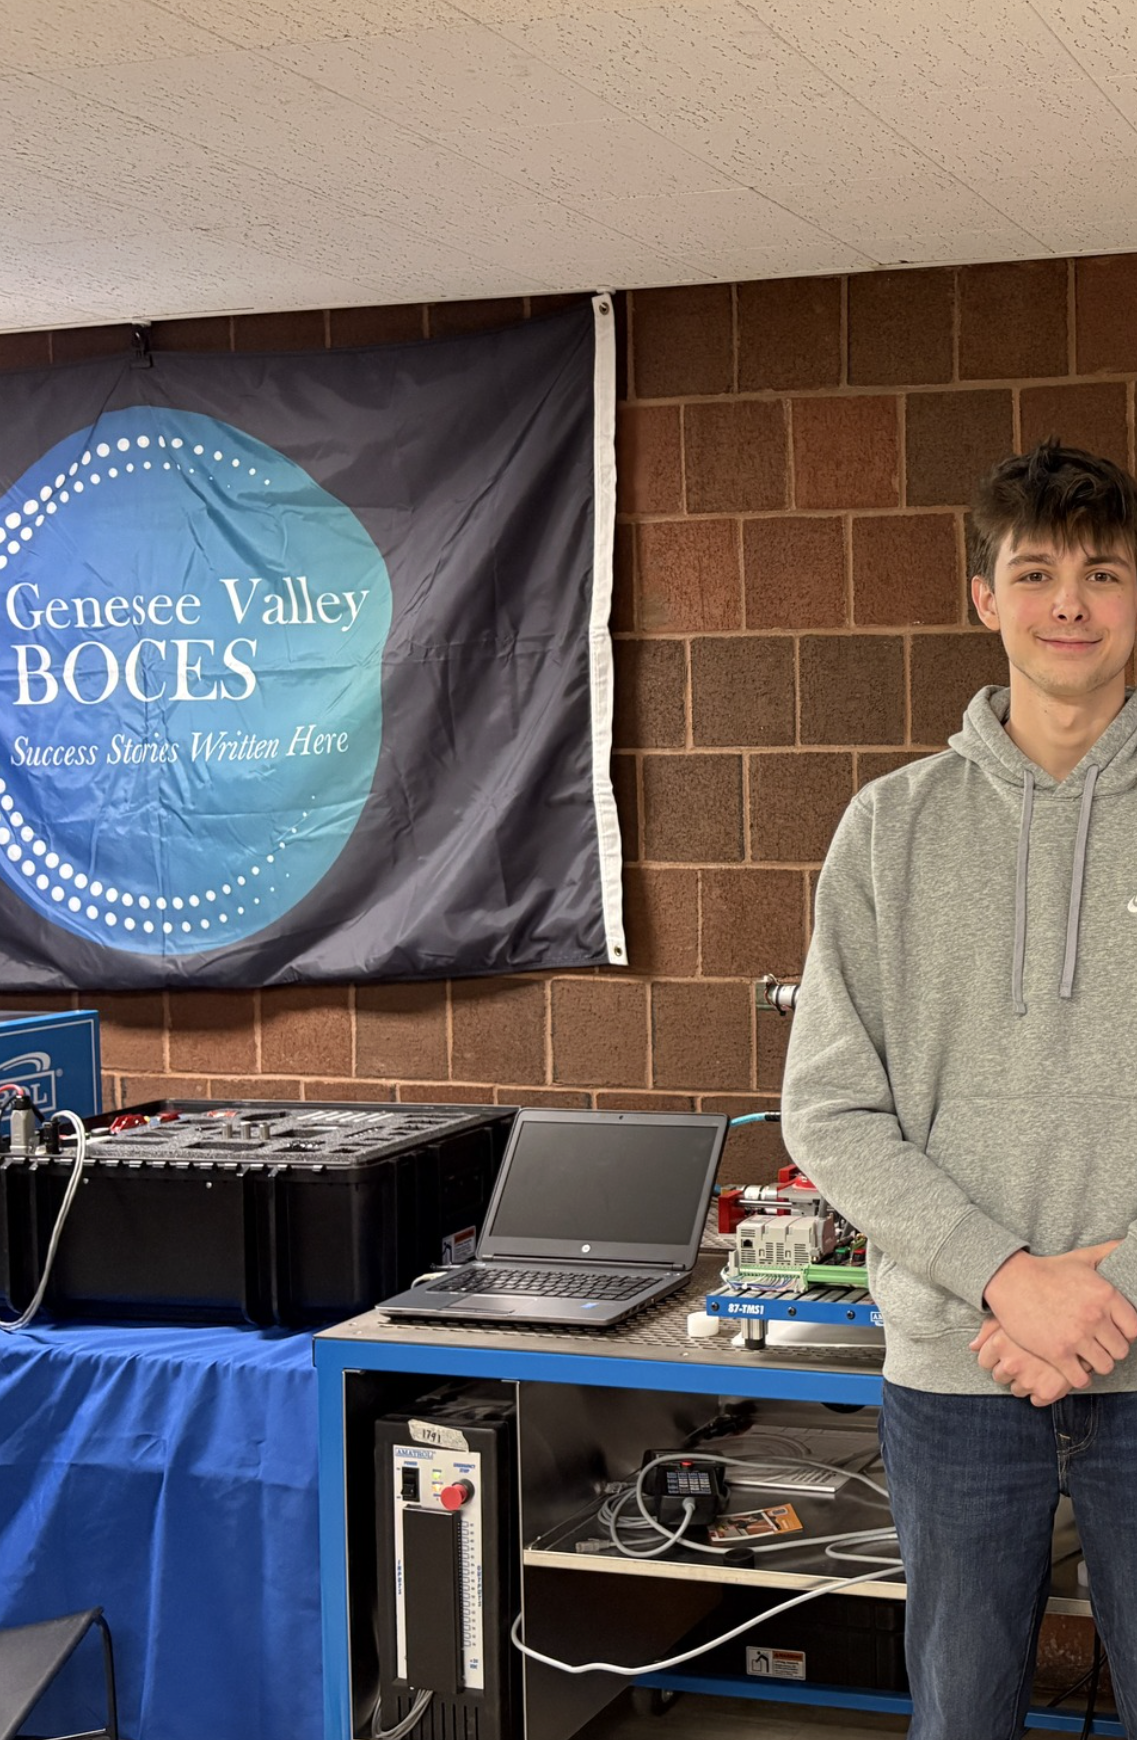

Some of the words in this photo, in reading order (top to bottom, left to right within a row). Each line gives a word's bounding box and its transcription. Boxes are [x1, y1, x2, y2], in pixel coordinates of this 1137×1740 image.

[6, 582, 201, 631] Genesee
[219, 576, 370, 632] Valley
[11, 637, 258, 706] BOCES
[11, 735, 98, 767] Success
[106, 732, 180, 765] Stories
[191, 730, 279, 763] Written
[286, 723, 349, 757] Here
[728, 1302, 764, 1315] 87-TMS1
